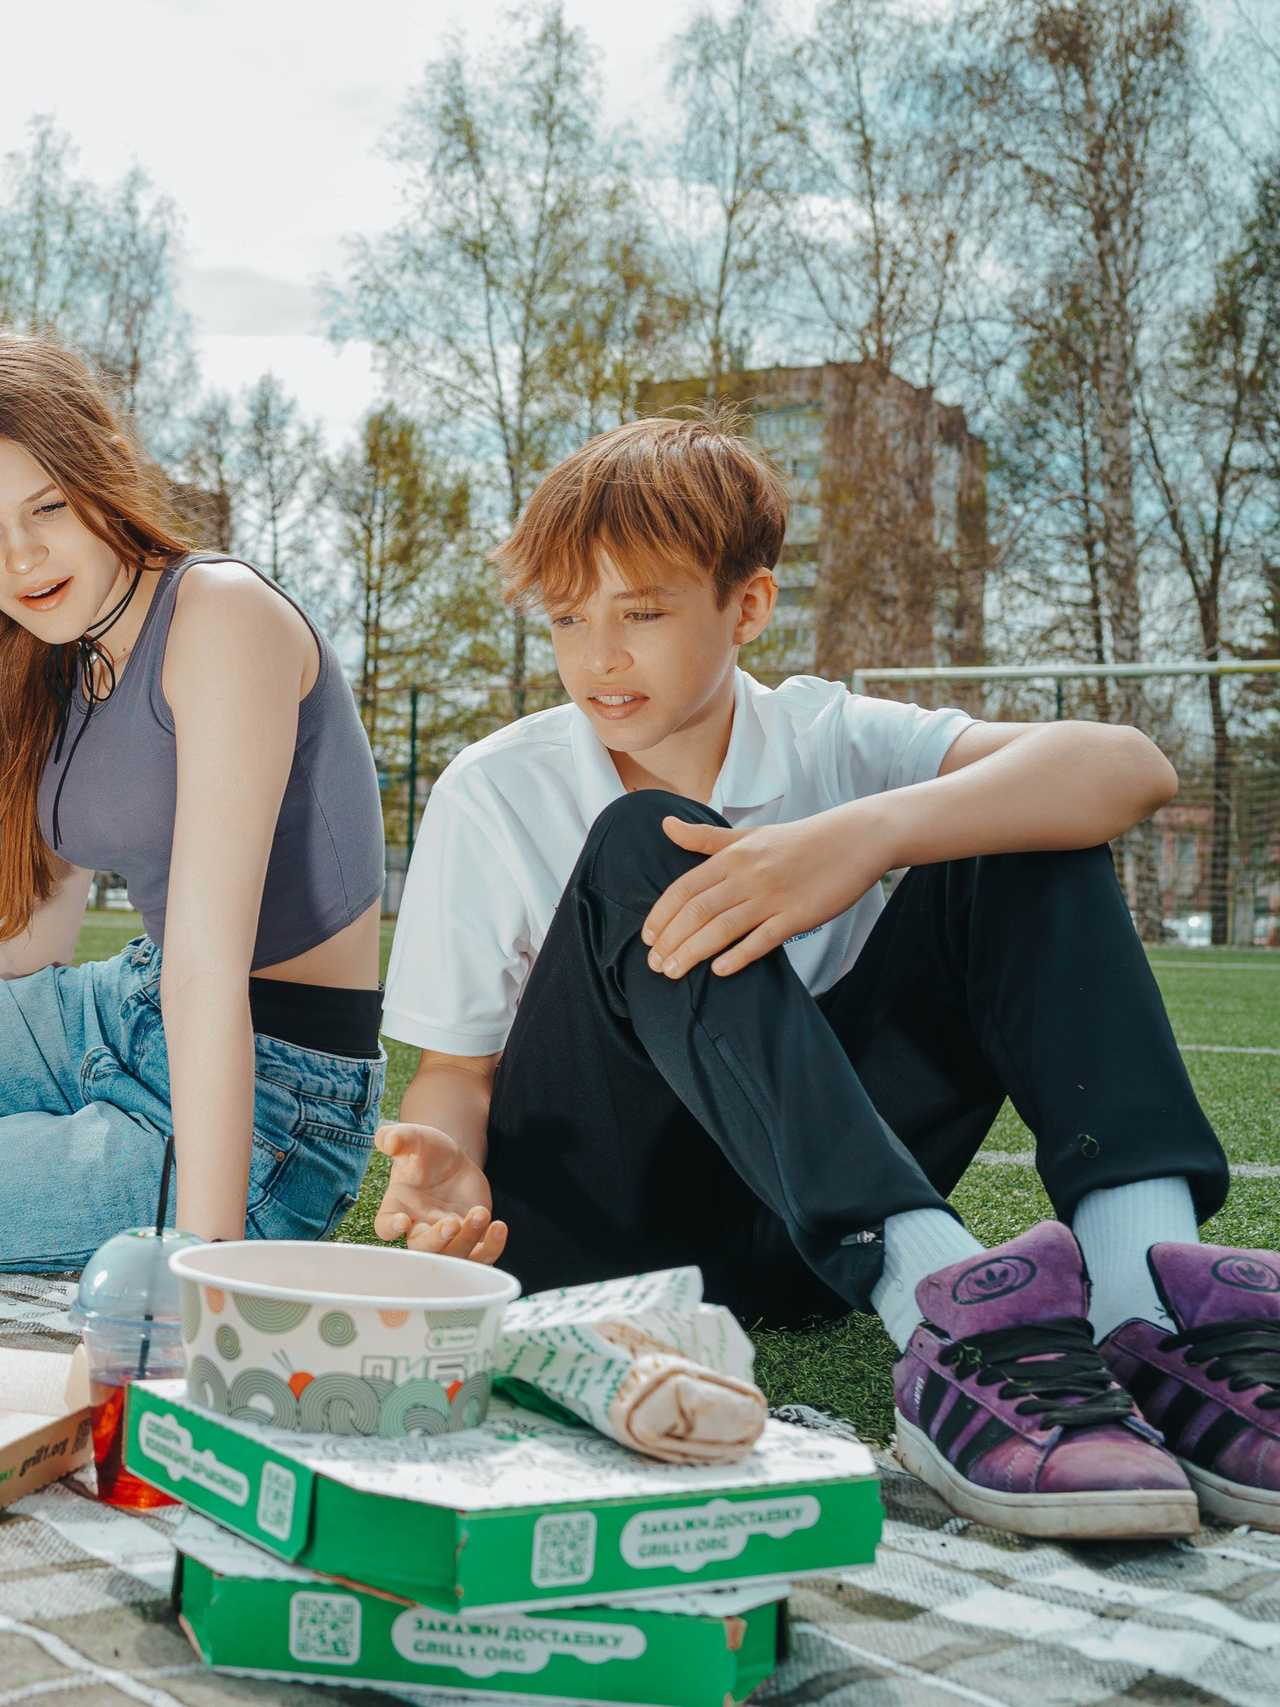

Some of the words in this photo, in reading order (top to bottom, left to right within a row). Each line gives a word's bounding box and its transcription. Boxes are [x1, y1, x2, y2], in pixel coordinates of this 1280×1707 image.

[639, 1516, 710, 1536] ЗАКАЖИ
[713, 1507, 803, 1530] ДОСТАВКУ
[414, 1617, 499, 1638] ЗАКАЖИ
[504, 1625, 624, 1649] ДОСТАВКУ
[413, 1639, 527, 1662] GRILL1.ORG
